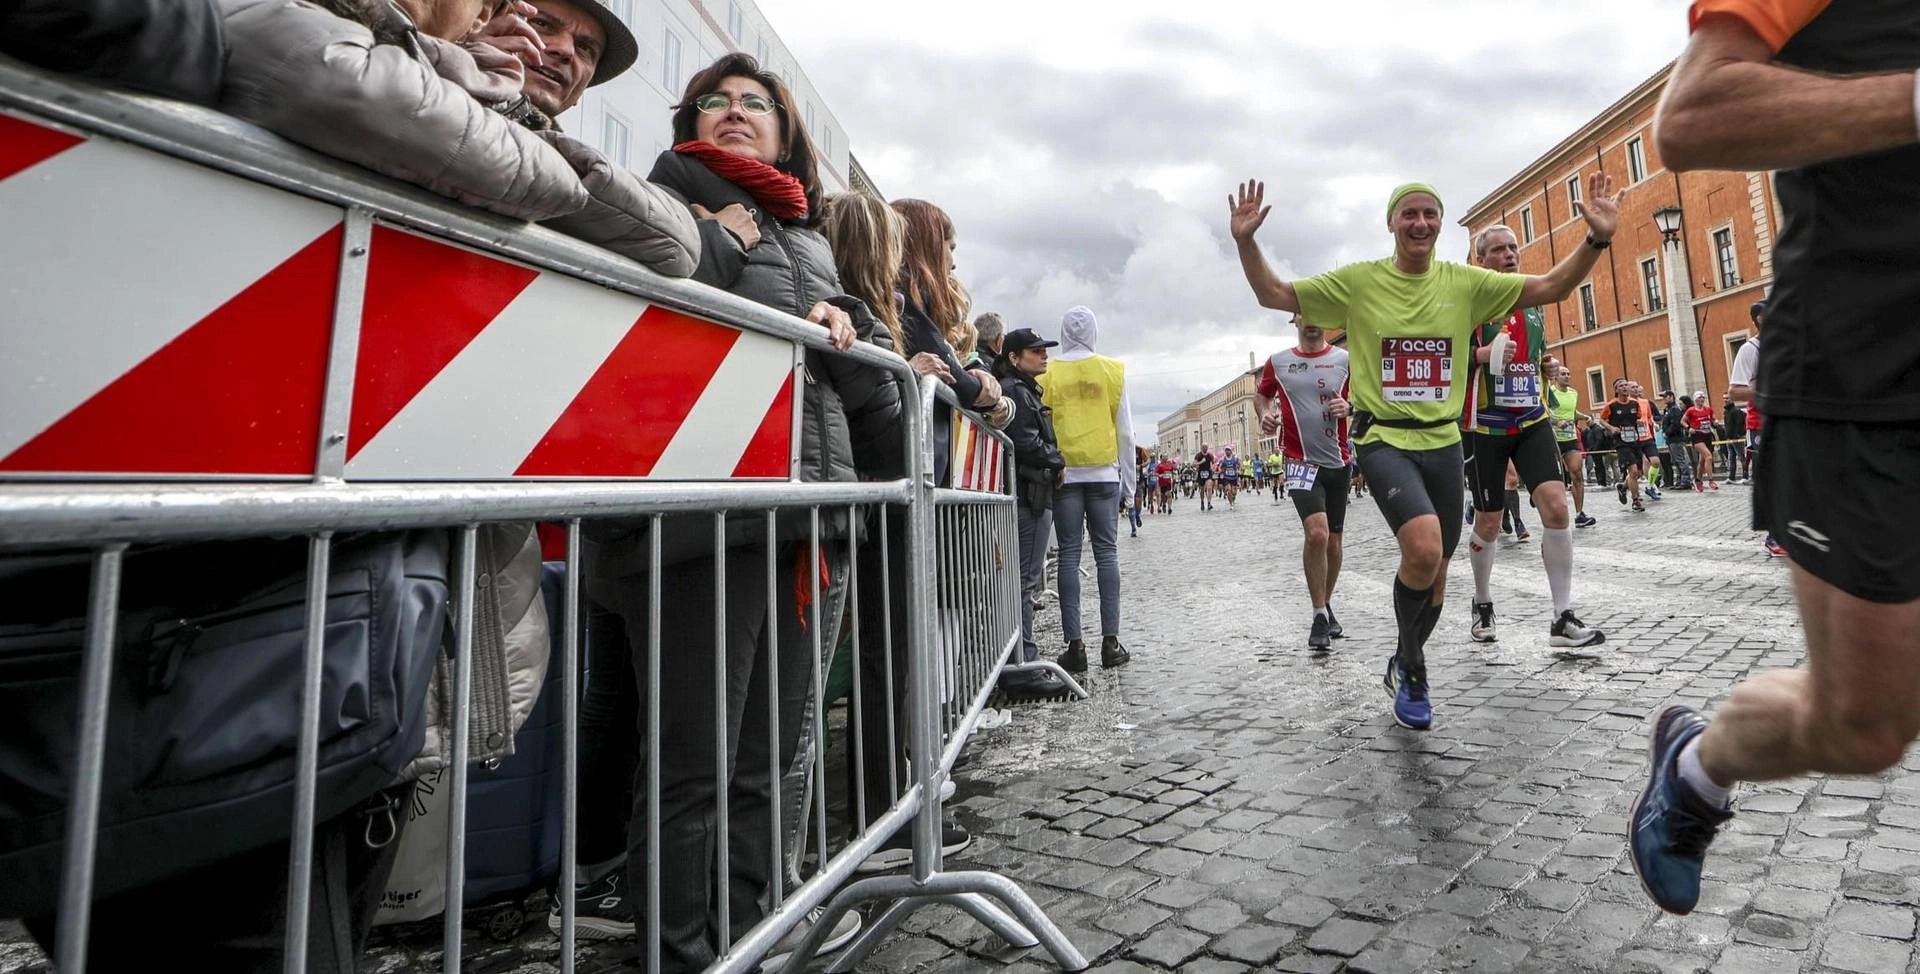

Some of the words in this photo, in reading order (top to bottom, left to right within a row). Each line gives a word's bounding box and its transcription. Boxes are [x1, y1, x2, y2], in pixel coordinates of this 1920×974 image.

[1389, 339, 1397, 349] 7
[1402, 340, 1447, 351] acea
[1407, 359, 1431, 379] 568
[1510, 363, 1535, 371] acea
[1512, 376, 1529, 392] 982
[1287, 463, 1304, 477] 1613
[389, 889, 422, 904] tiger
